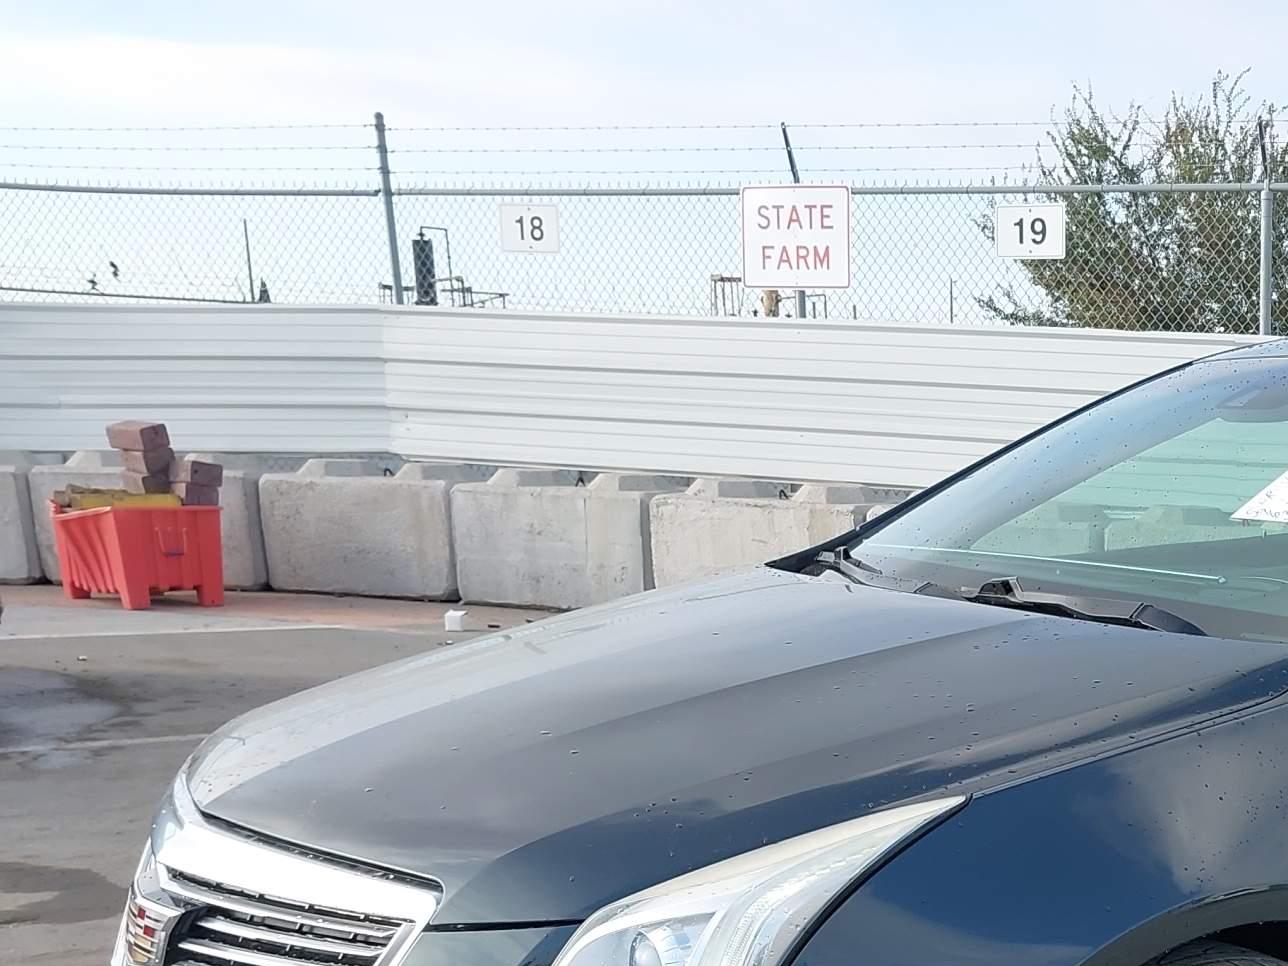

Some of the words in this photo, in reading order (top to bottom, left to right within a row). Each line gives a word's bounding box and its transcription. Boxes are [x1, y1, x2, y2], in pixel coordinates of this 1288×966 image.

[515, 215, 544, 242] 18
[757, 204, 834, 230] STATE
[1014, 217, 1047, 245] 19
[761, 245, 830, 271] FARM
